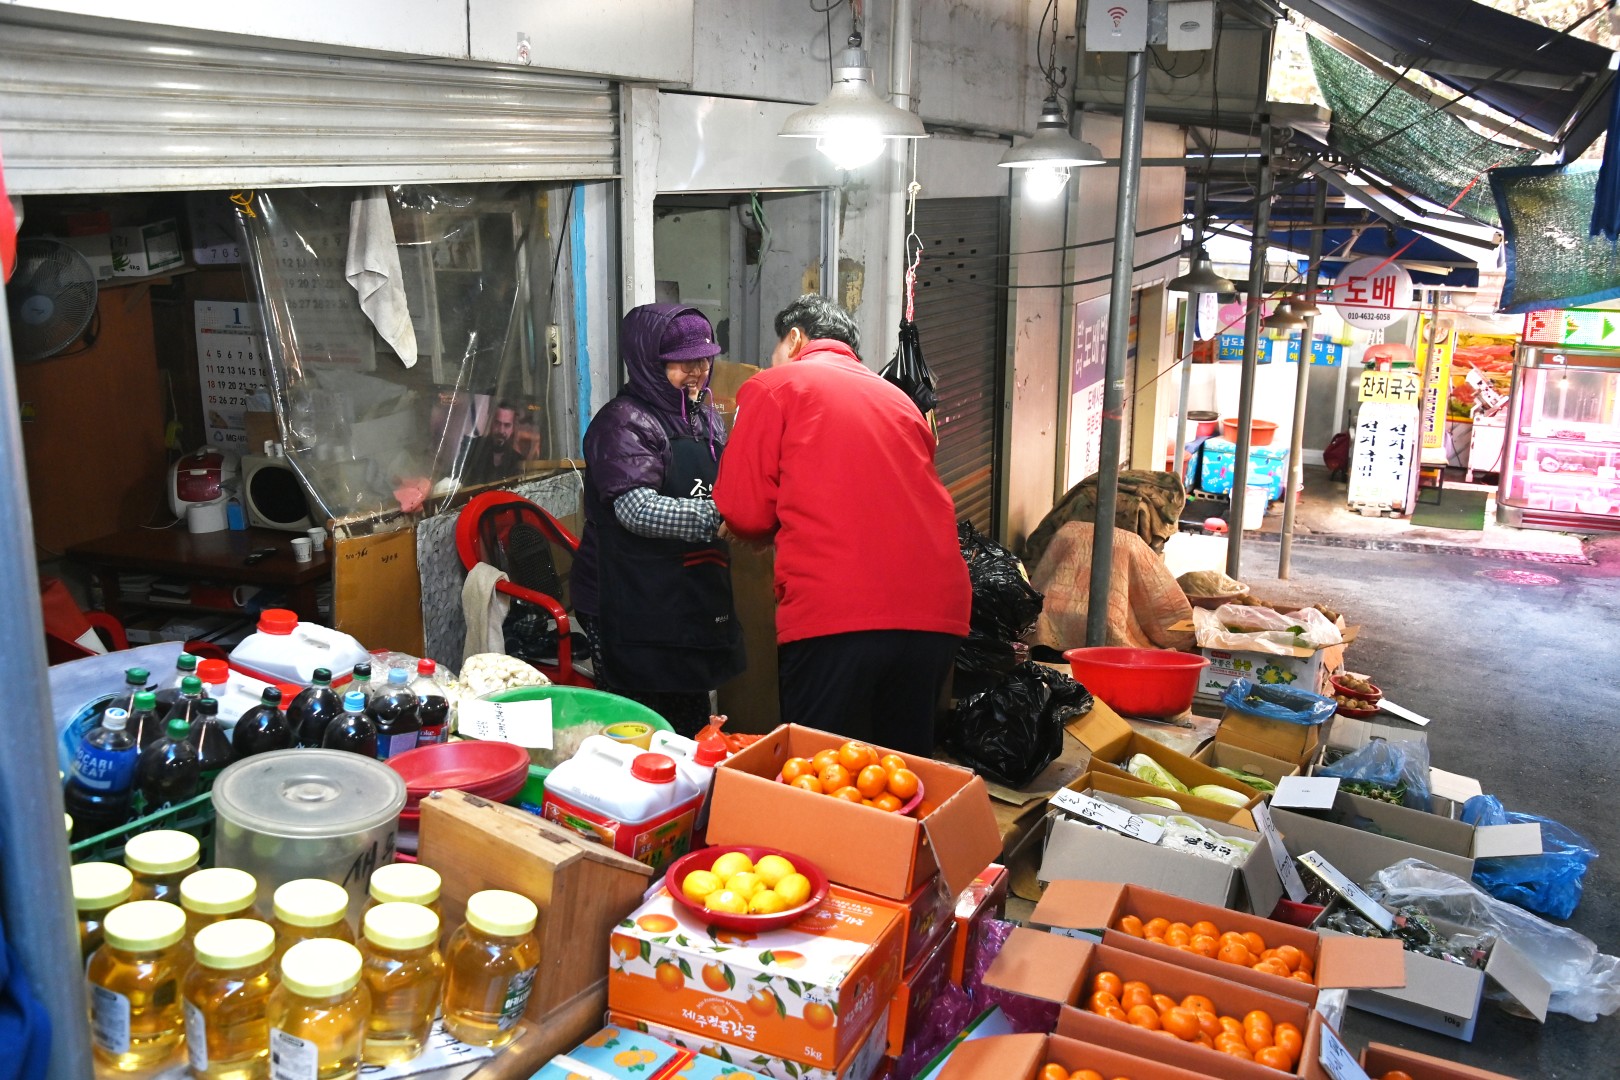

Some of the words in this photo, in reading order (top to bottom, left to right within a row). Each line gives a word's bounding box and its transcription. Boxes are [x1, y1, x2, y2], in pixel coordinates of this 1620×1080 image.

[1344, 275, 1396, 308] 도배
[233, 307, 242, 324] 1
[1290, 342, 1335, 354] 가리찜
[206, 350, 211, 358] 4
[217, 350, 222, 358] 5
[228, 350, 232, 358] 6
[238, 351, 242, 359] 7
[248, 352, 253, 360] 8
[206, 365, 214, 374] 11
[216, 366, 224, 374] 12
[227, 366, 235, 374] 13
[238, 367, 246, 376] 14
[248, 368, 256, 376] 15
[208, 380, 216, 389] 18
[218, 381, 226, 389] 19
[228, 382, 236, 390] 20
[1363, 376, 1416, 400] 잔치국수
[208, 396, 216, 404] 25
[219, 396, 227, 404] 26
[230, 396, 238, 404] 27
[804, 1046, 823, 1061] 5kg
